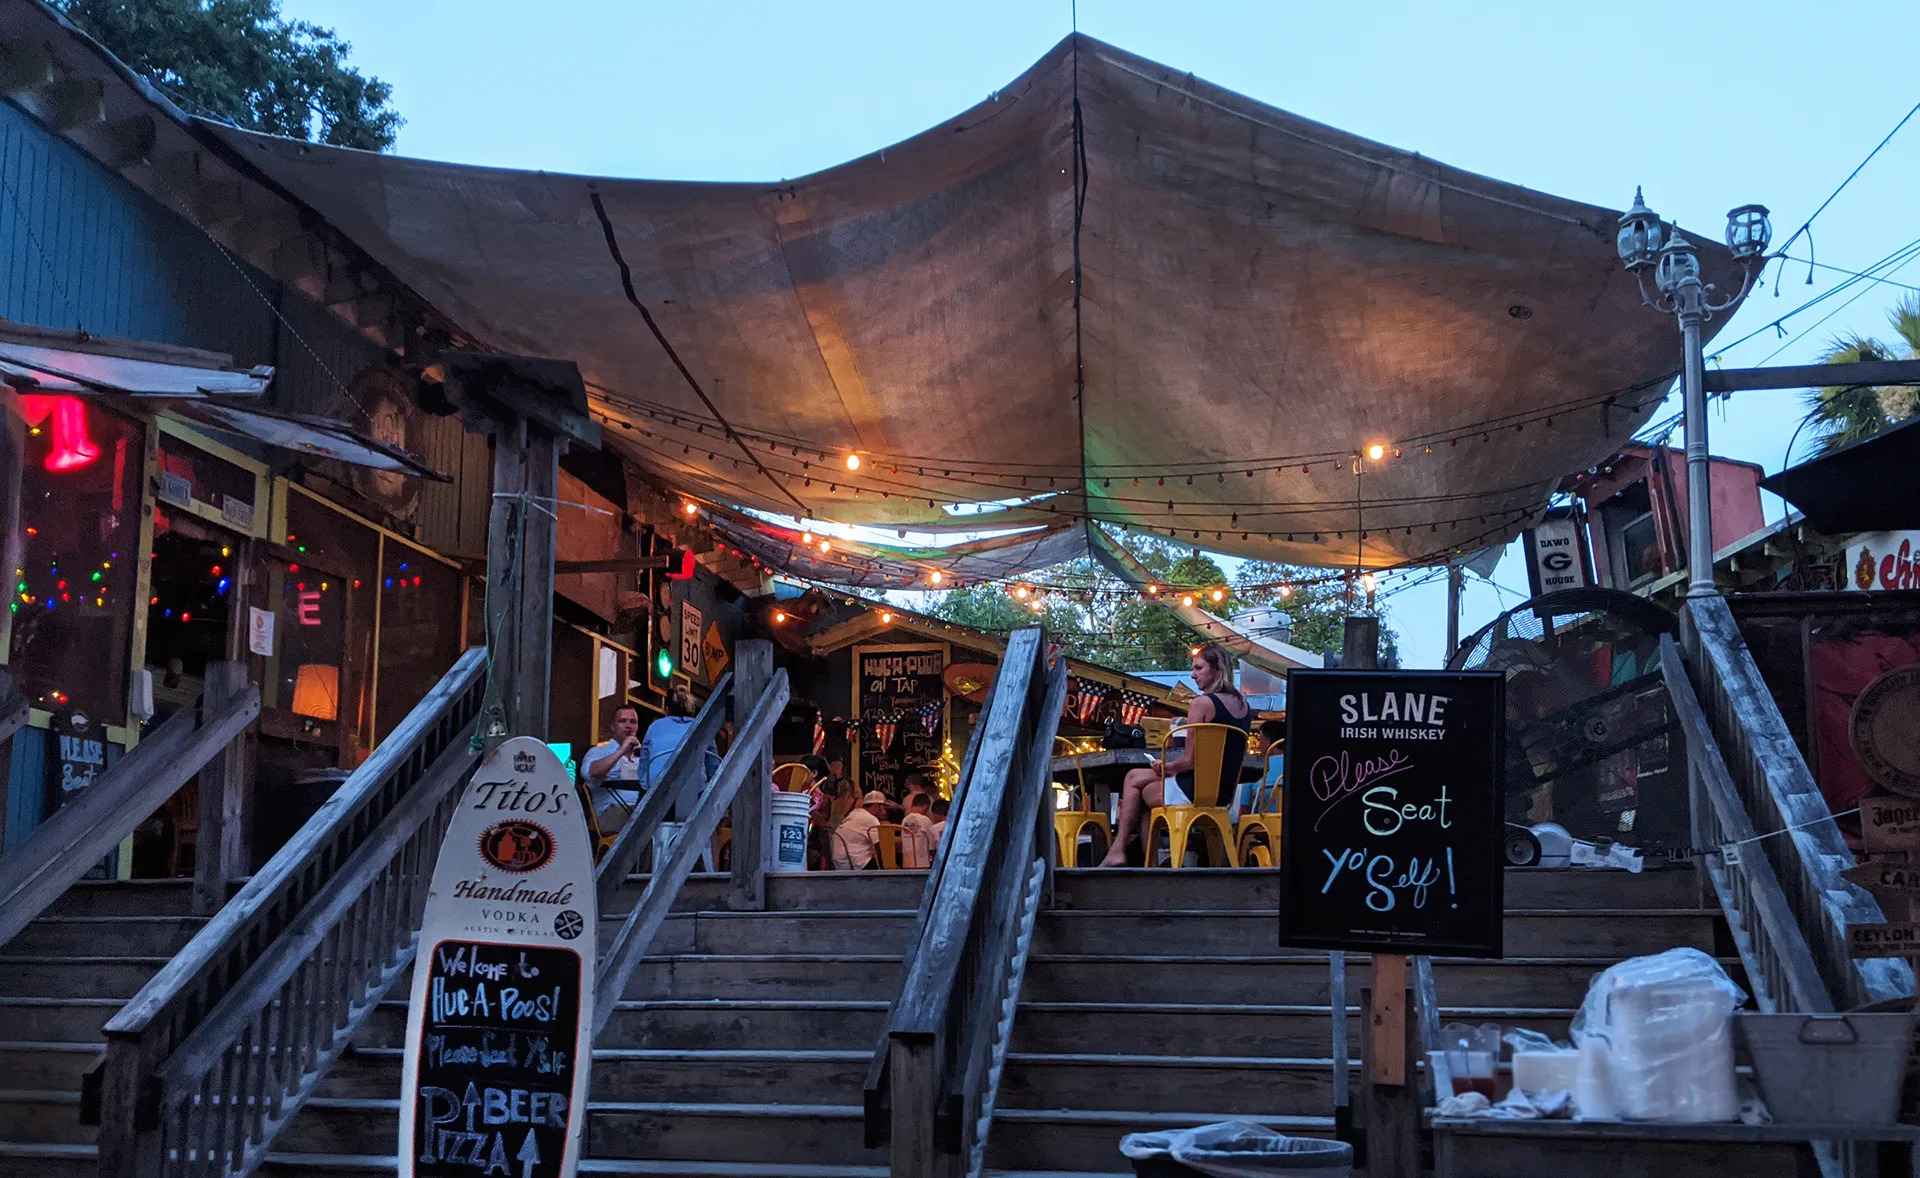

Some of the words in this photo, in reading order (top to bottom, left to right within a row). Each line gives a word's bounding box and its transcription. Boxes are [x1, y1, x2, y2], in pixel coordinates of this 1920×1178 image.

[1543, 552, 1572, 570] G
[1545, 576, 1575, 585] HOUSE
[683, 609, 701, 628] SPEED
[683, 637, 699, 668] 30
[891, 677, 919, 694] TAP
[1339, 691, 1448, 726] SLANE
[1340, 727, 1377, 740] IRISH
[1381, 727, 1447, 741] WHISKEY
[1310, 748, 1410, 802] Please
[473, 778, 569, 814] Tito's
[1362, 785, 1453, 837] Seat
[453, 878, 574, 906] Handmade
[481, 908, 540, 924] VODKA
[483, 1087, 570, 1129] BEER
[419, 1085, 512, 1177] PIZZA
